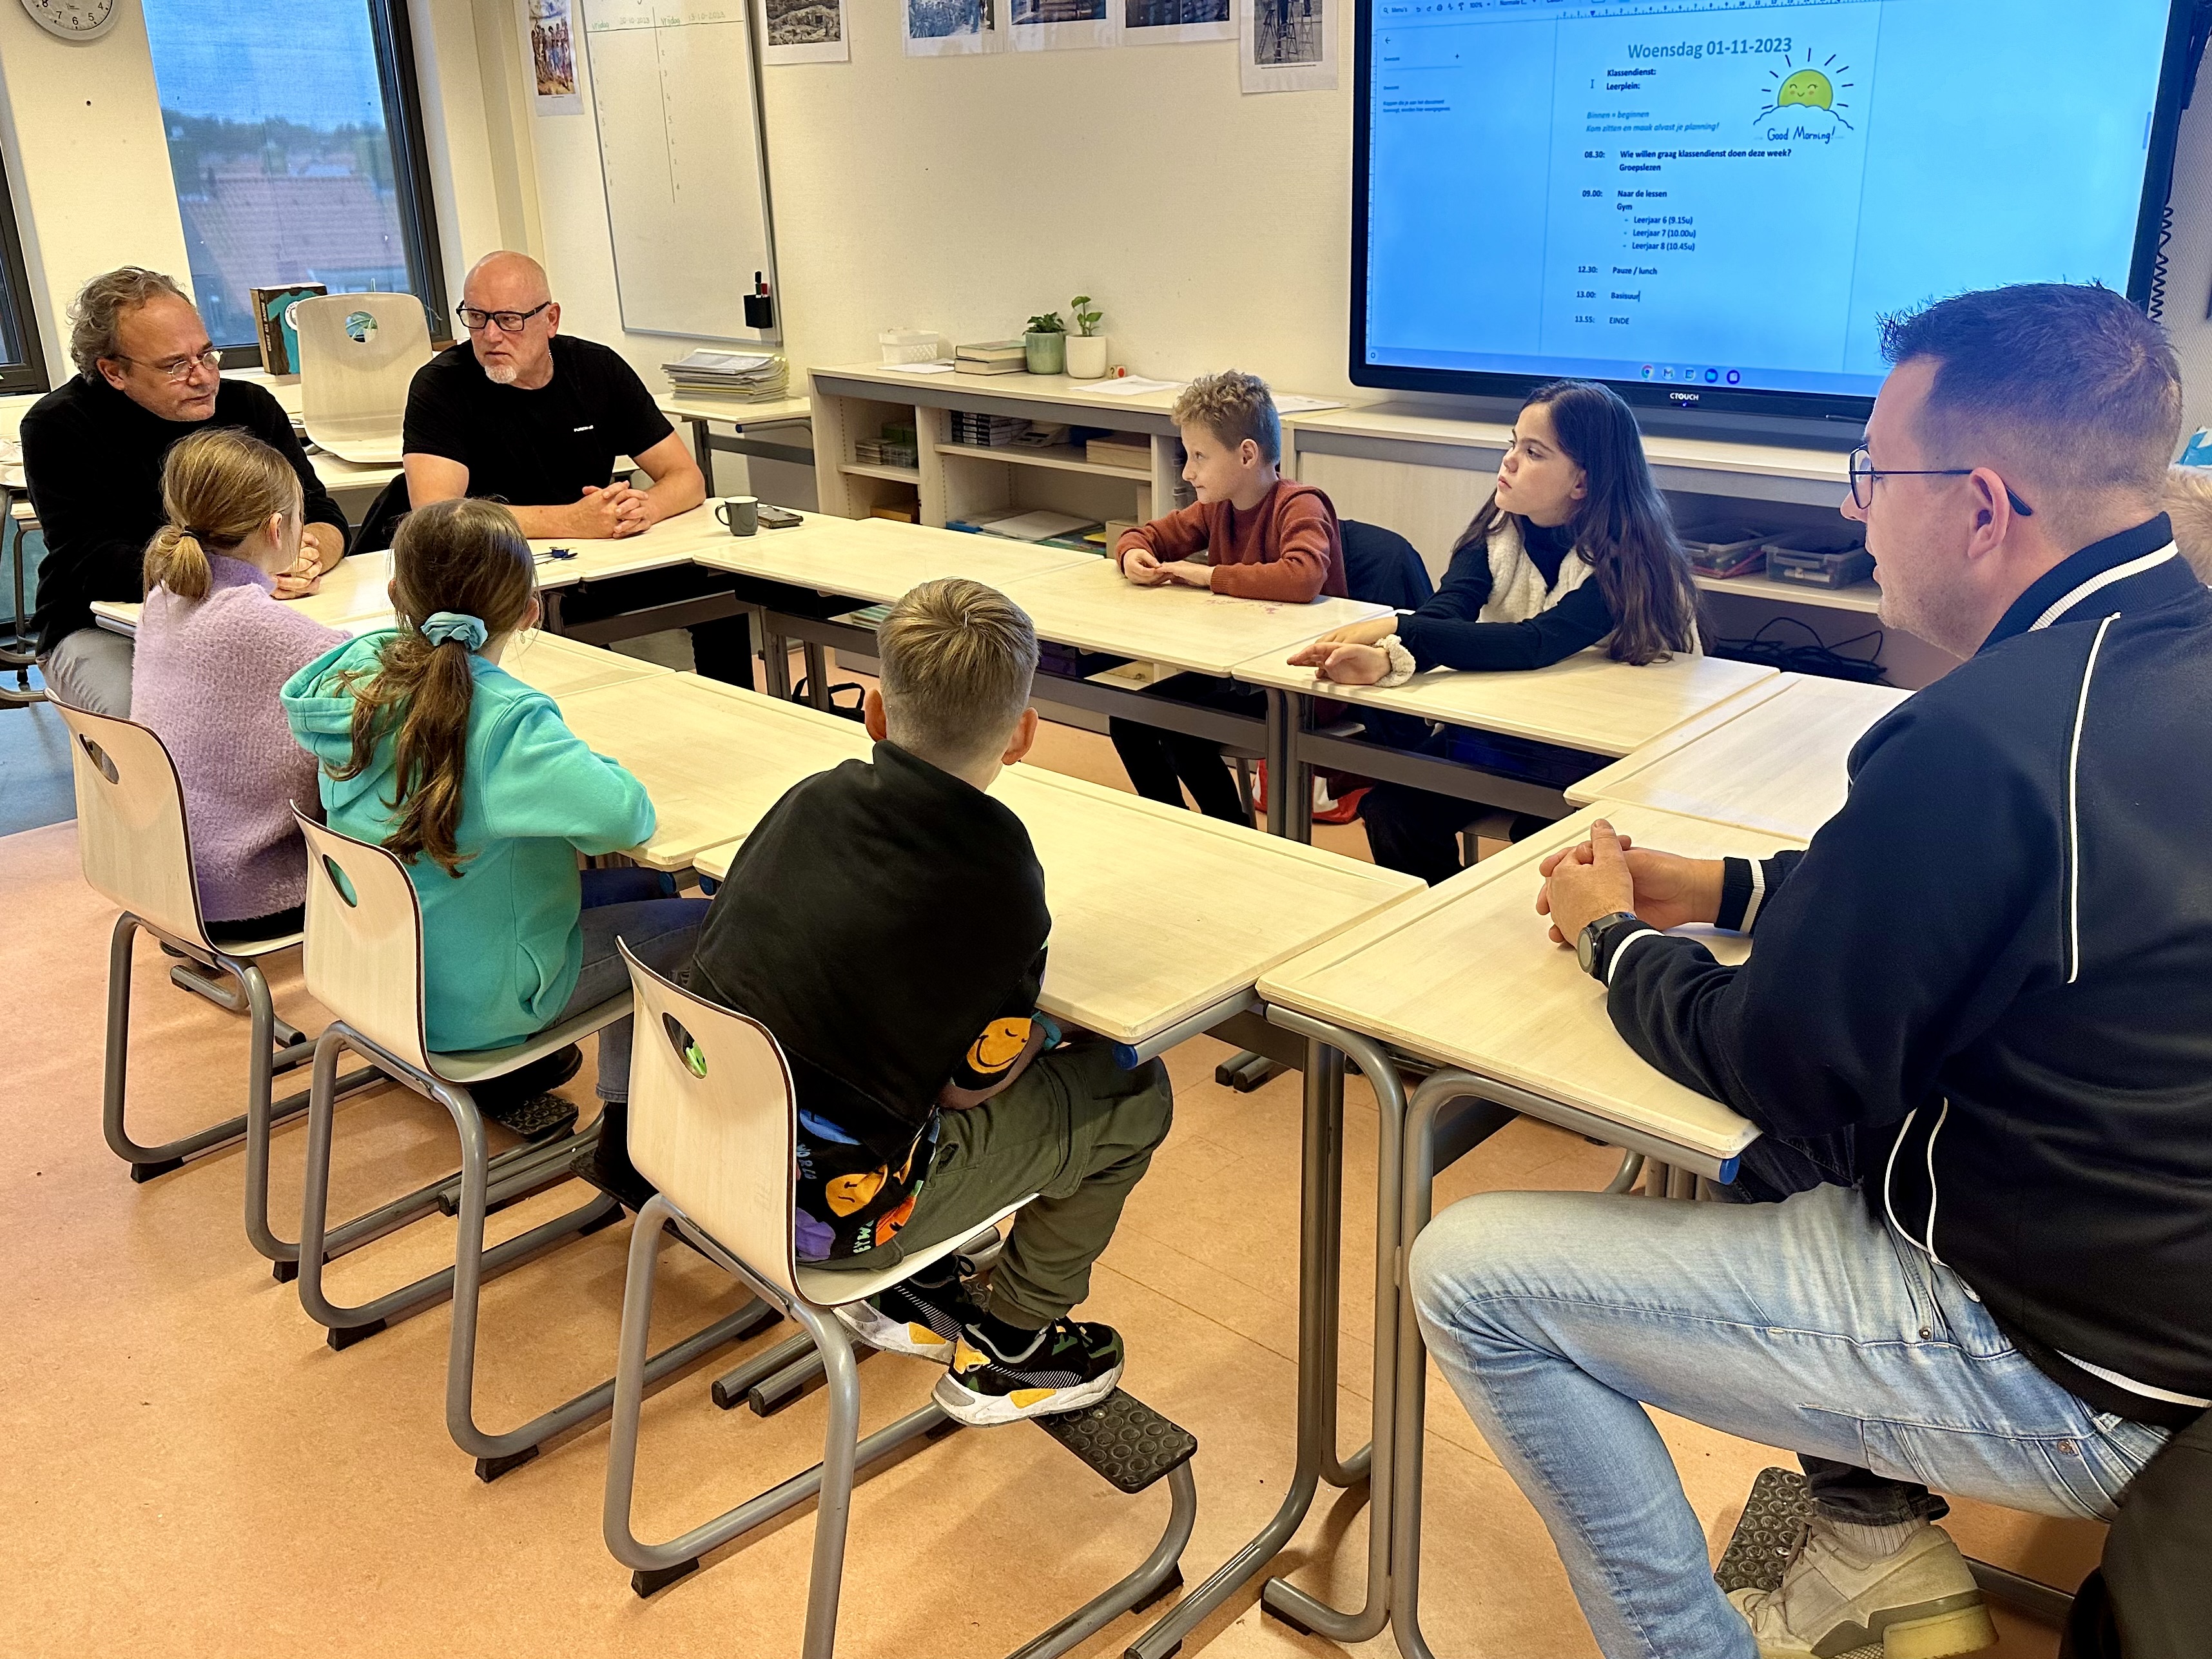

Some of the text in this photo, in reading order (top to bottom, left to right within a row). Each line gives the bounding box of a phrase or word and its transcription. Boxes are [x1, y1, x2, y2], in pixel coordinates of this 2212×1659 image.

[72, 16, 79, 25] 6
[88, 13, 94, 21] 5
[1628, 37, 1792, 59] Woensdag 01-11-2023
[1607, 68, 1656, 77] Klassendienst:
[1606, 82, 1640, 91] Leerplein:
[1617, 111, 1649, 119] beginnen
[1676, 124, 1683, 133] je
[1684, 122, 1720, 133] planning!
[1767, 126, 1836, 144] Good Morning!
[1620, 150, 1634, 159] Wie
[1657, 151, 1676, 159] graag
[1748, 149, 1765, 157] deze
[1767, 149, 1792, 157] week?
[1619, 164, 1661, 172] Groepslezen
[1616, 203, 1633, 211] Gym
[1634, 217, 1661, 225] Leerjaar
[1668, 216, 1693, 225] (9.15u)
[1633, 229, 1660, 238] Leerjaar
[1667, 229, 1696, 238] (10.00u)
[1632, 242, 1659, 251] Leerjaar
[1666, 242, 1695, 251] (10.45u)
[1633, 267, 1638, 275] /
[1110, 367, 1115, 378] ?
[1670, 393, 1699, 401] CTOUCH
